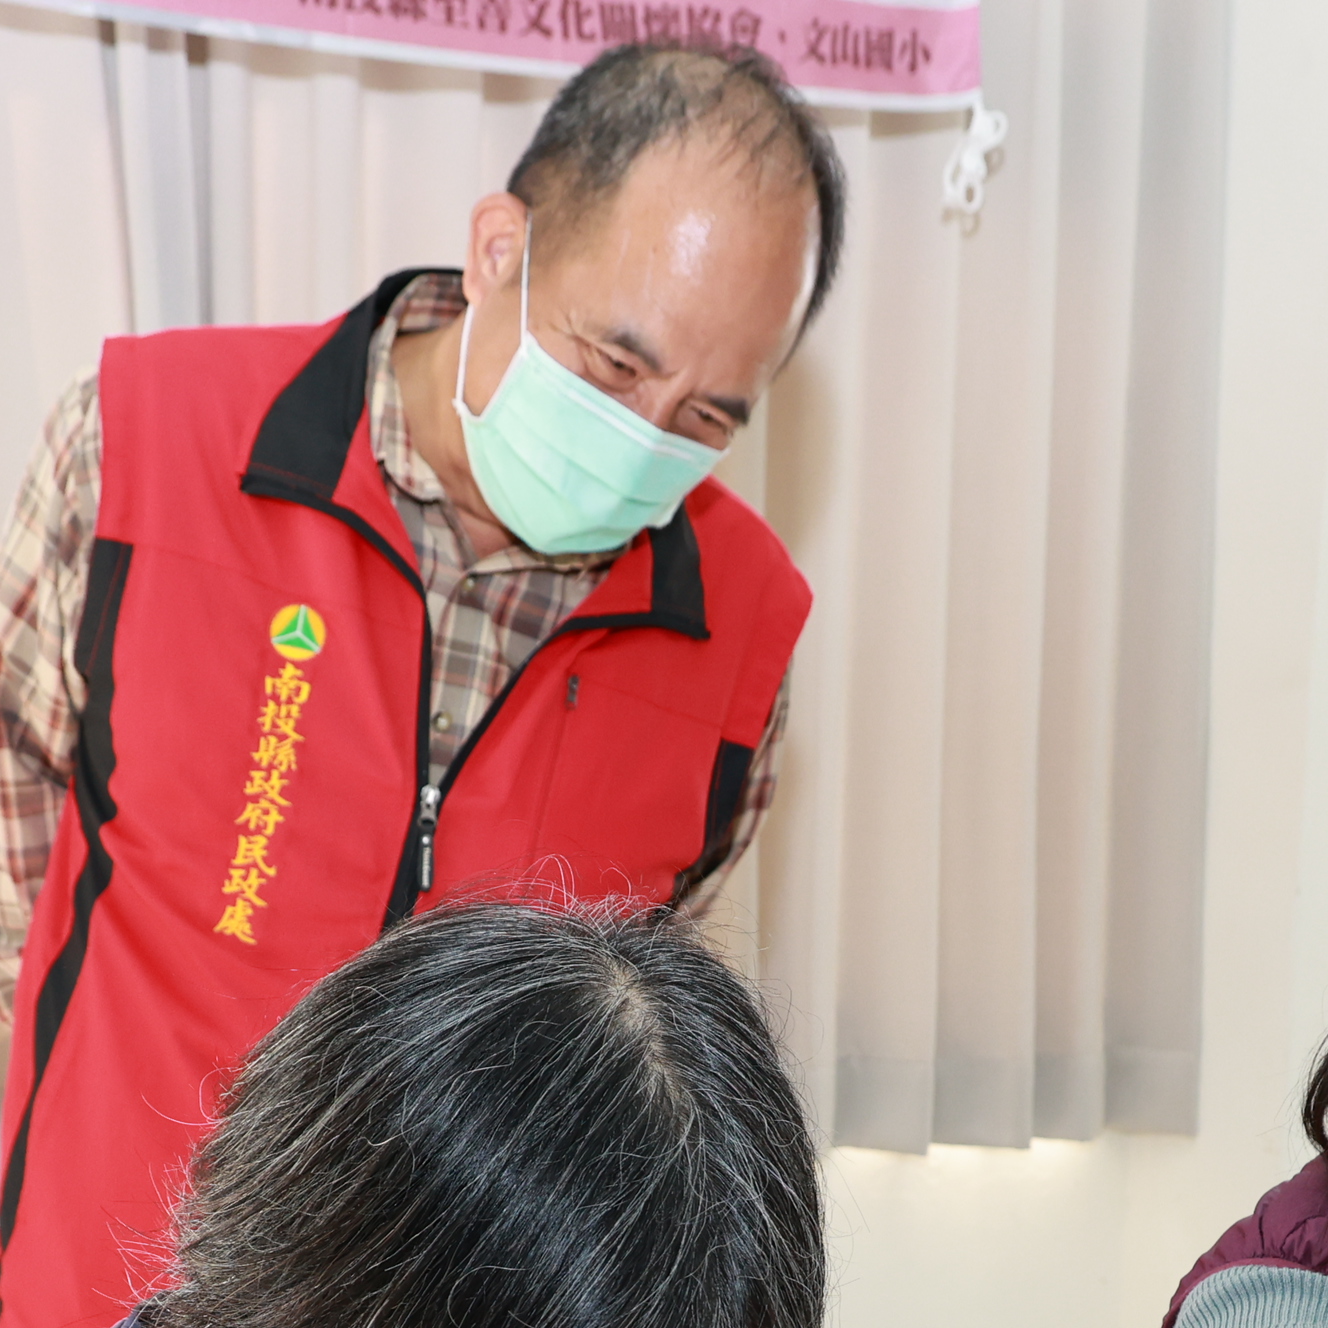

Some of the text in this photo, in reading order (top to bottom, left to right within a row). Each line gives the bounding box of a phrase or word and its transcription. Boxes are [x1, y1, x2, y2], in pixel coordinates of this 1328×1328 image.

[213, 661, 312, 946] 南投縣政府民政處
